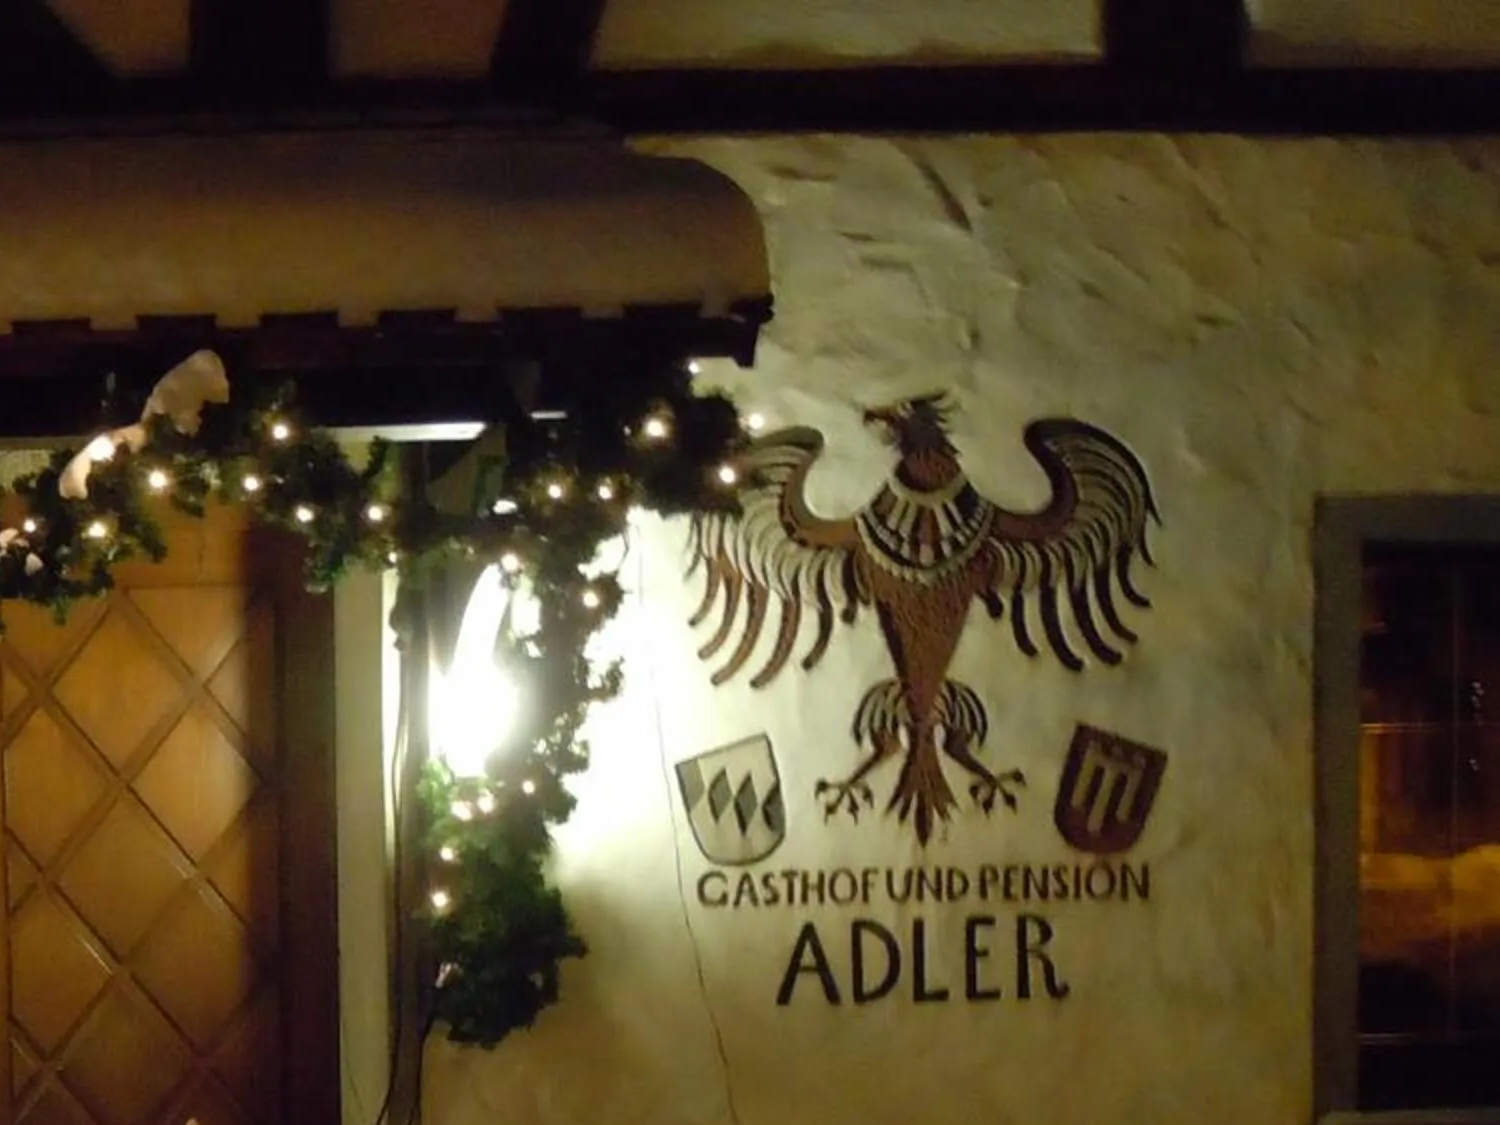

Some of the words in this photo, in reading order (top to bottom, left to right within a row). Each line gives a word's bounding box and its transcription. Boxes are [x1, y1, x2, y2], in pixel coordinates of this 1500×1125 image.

[696, 867, 877, 909] GASTHOF
[885, 866, 970, 902] UND
[978, 862, 1150, 901] PENSION
[776, 913, 1070, 1006] ADLER
